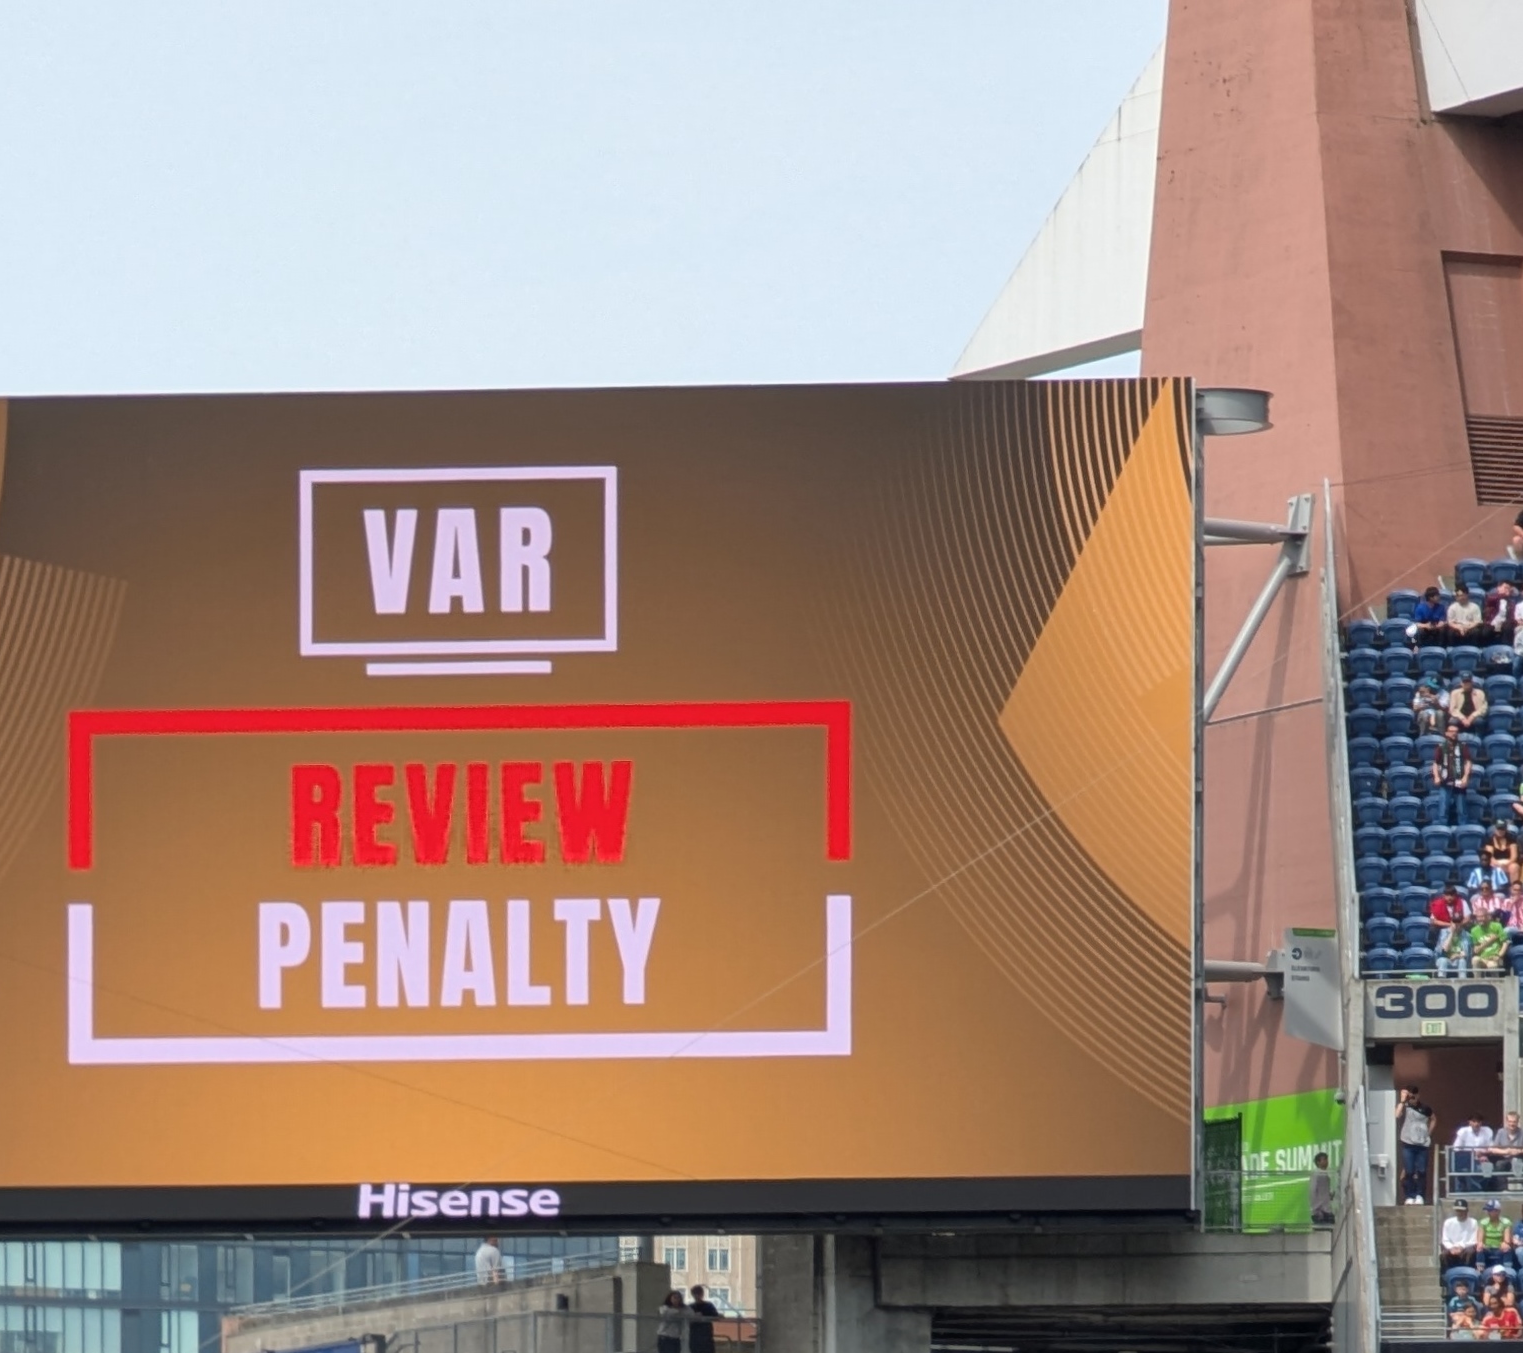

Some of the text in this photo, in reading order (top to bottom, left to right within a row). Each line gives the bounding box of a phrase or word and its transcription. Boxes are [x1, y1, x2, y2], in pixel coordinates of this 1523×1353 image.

[363, 506, 552, 615] VAR
[289, 759, 634, 868] REVIEW
[258, 897, 661, 1010] PENALTY
[1375, 984, 1498, 1019] 300
[357, 1179, 561, 1220] Hisense
